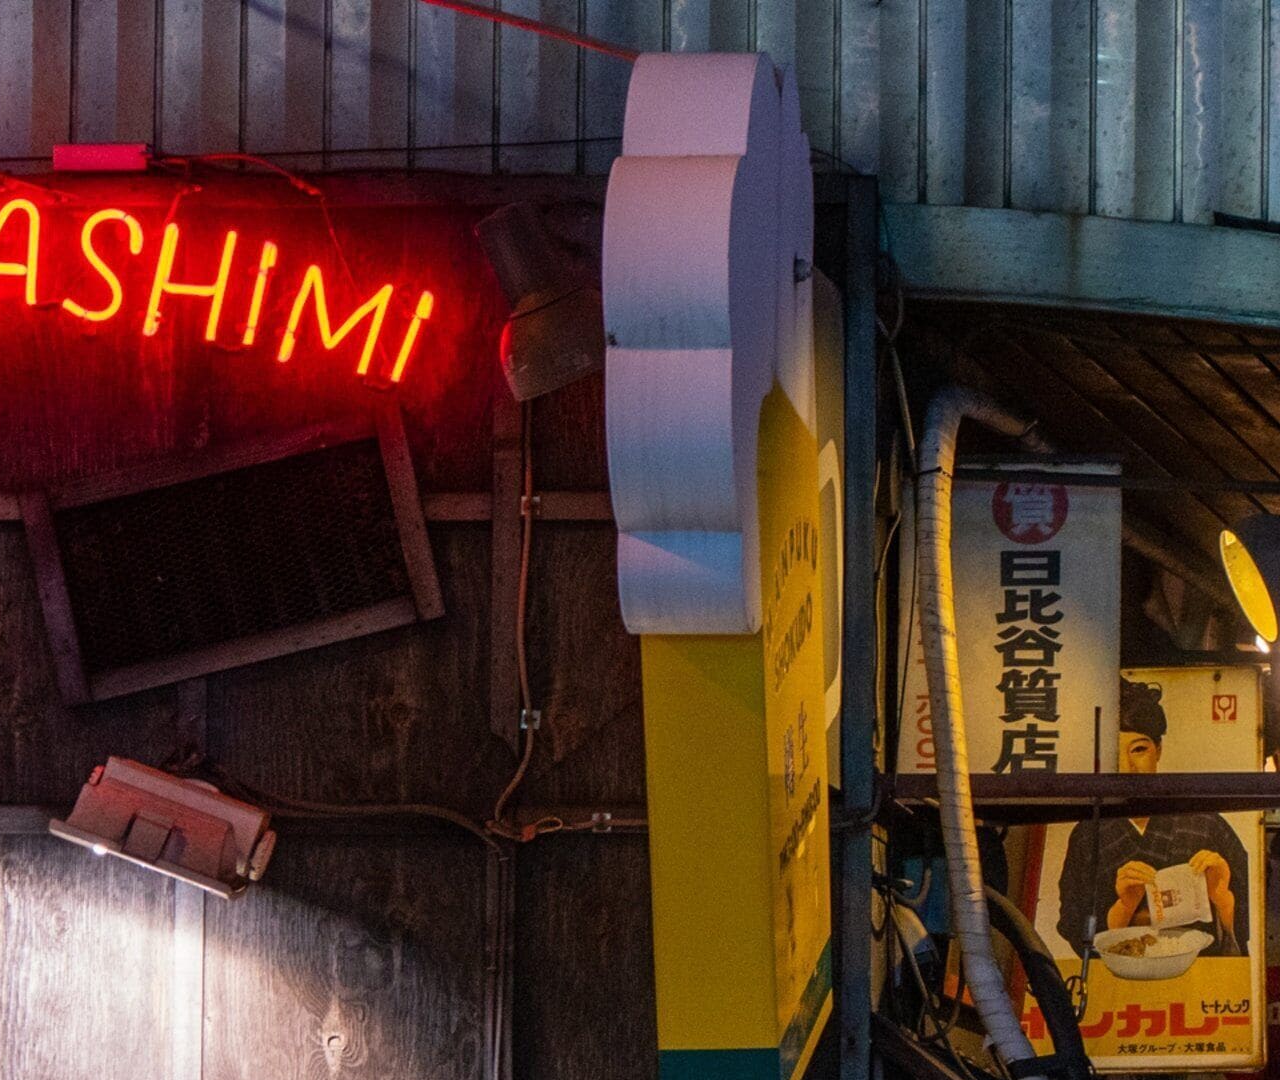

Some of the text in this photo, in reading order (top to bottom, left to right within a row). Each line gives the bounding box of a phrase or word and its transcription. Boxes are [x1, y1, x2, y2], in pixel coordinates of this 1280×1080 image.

[990, 550, 1066, 774] 日比谷質店
